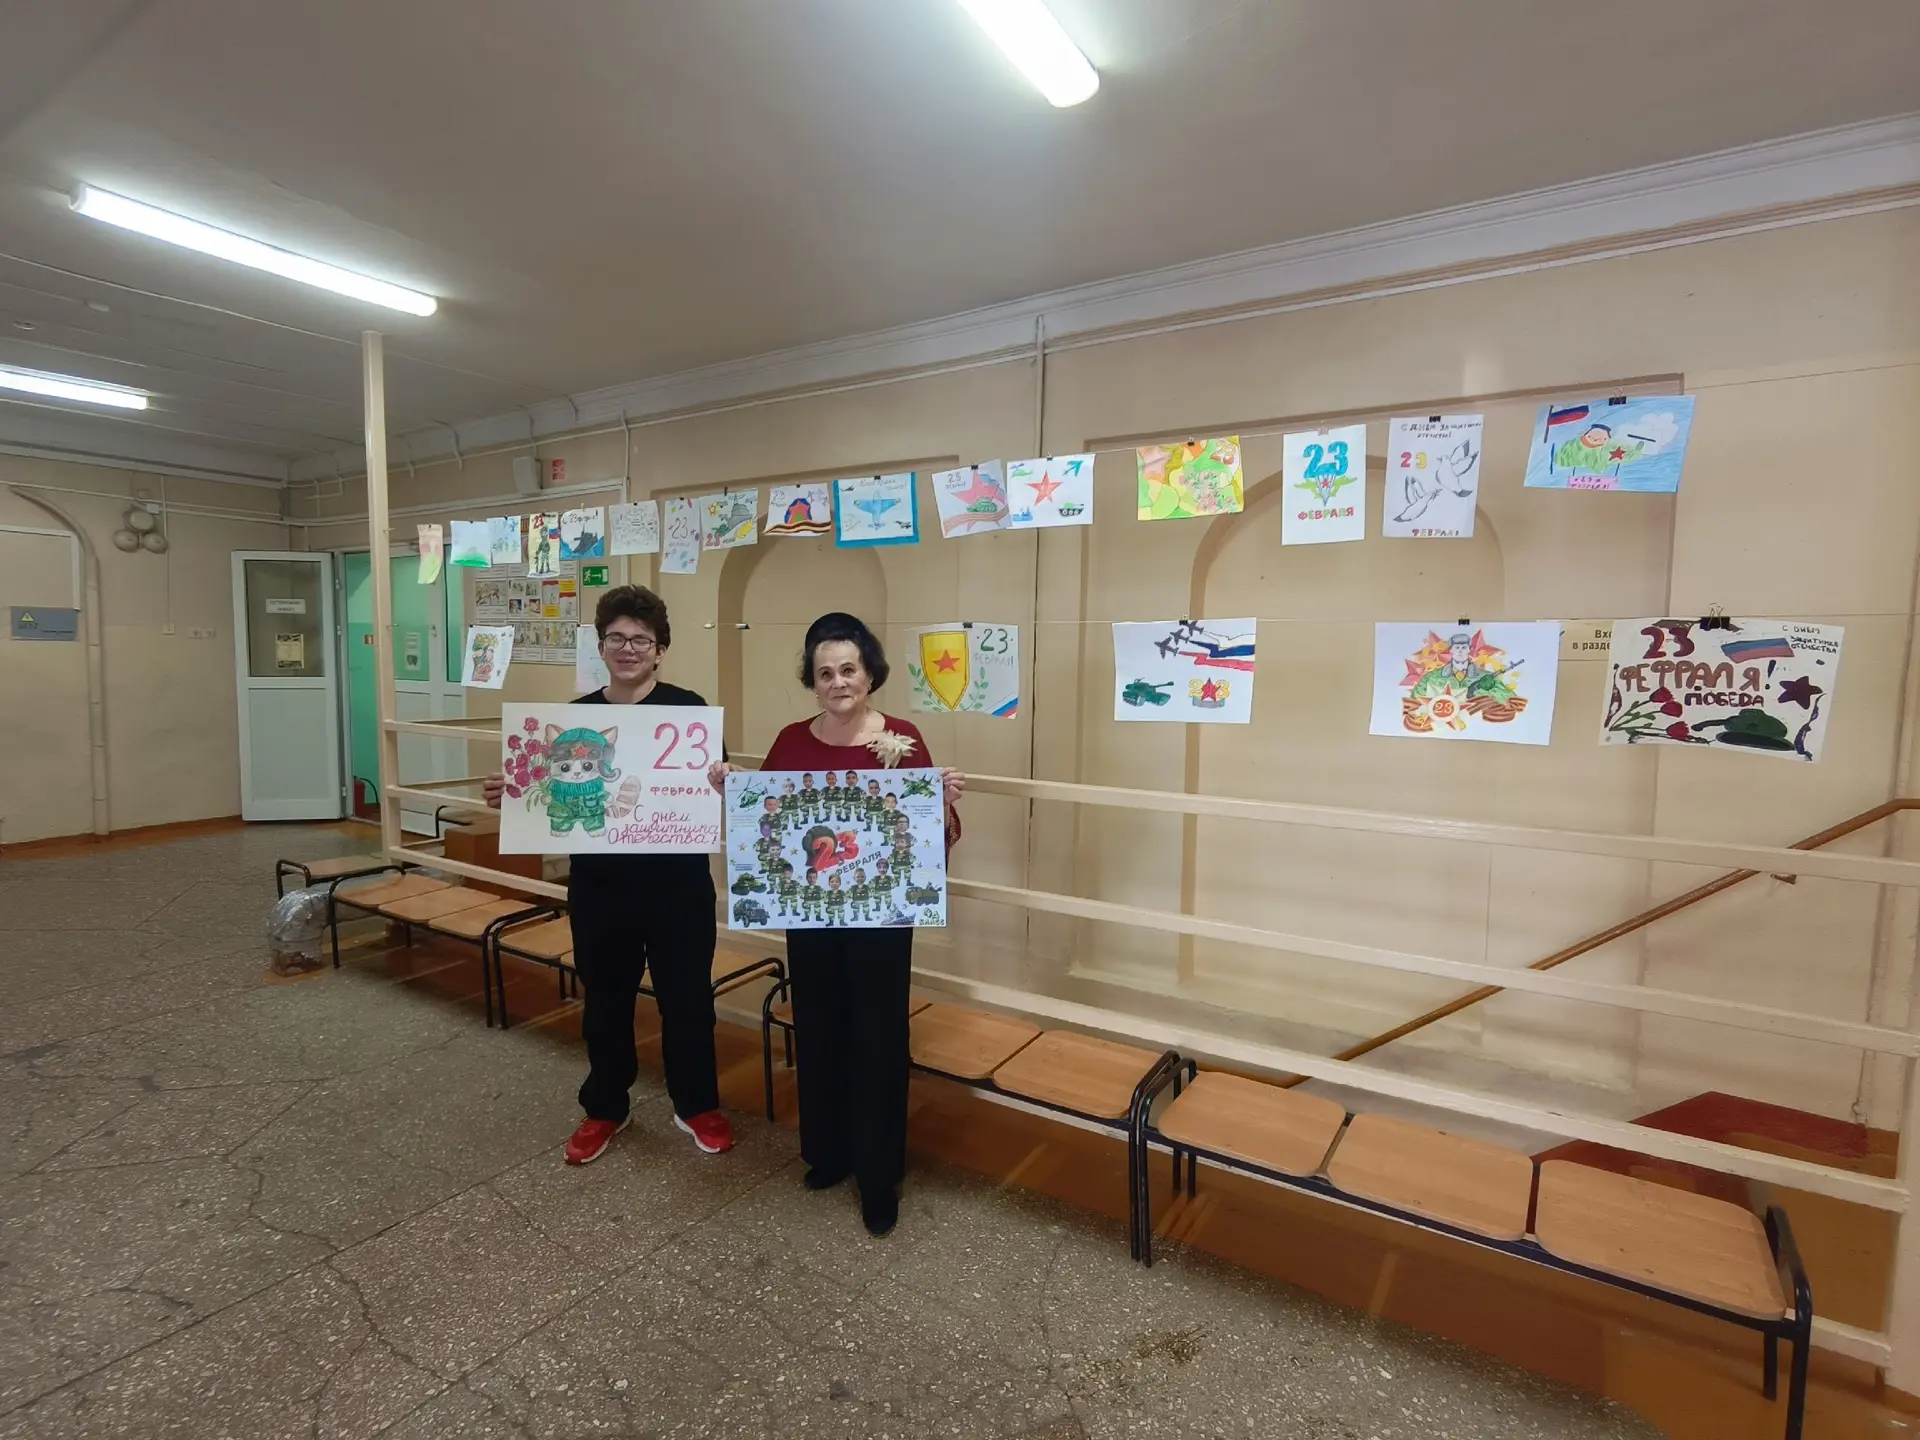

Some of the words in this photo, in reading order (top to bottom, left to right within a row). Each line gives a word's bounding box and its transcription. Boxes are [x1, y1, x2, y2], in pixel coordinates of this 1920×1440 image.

[1303, 440, 1349, 479] 23
[1400, 451, 1428, 470] 23
[534, 514, 545, 529] 23
[1297, 506, 1354, 521] ФЕВРАЛЯ
[672, 516, 689, 539] 23
[705, 532, 721, 547] 23
[980, 628, 1010, 654] 23
[1640, 626, 1695, 659] 23
[1433, 701, 1454, 716] 23
[1684, 690, 1765, 708] ПОБЕДА
[652, 721, 711, 771] 23
[633, 804, 644, 822] С
[812, 830, 860, 872] 23
[836, 850, 882, 876] ФЕВРАЛЯ
